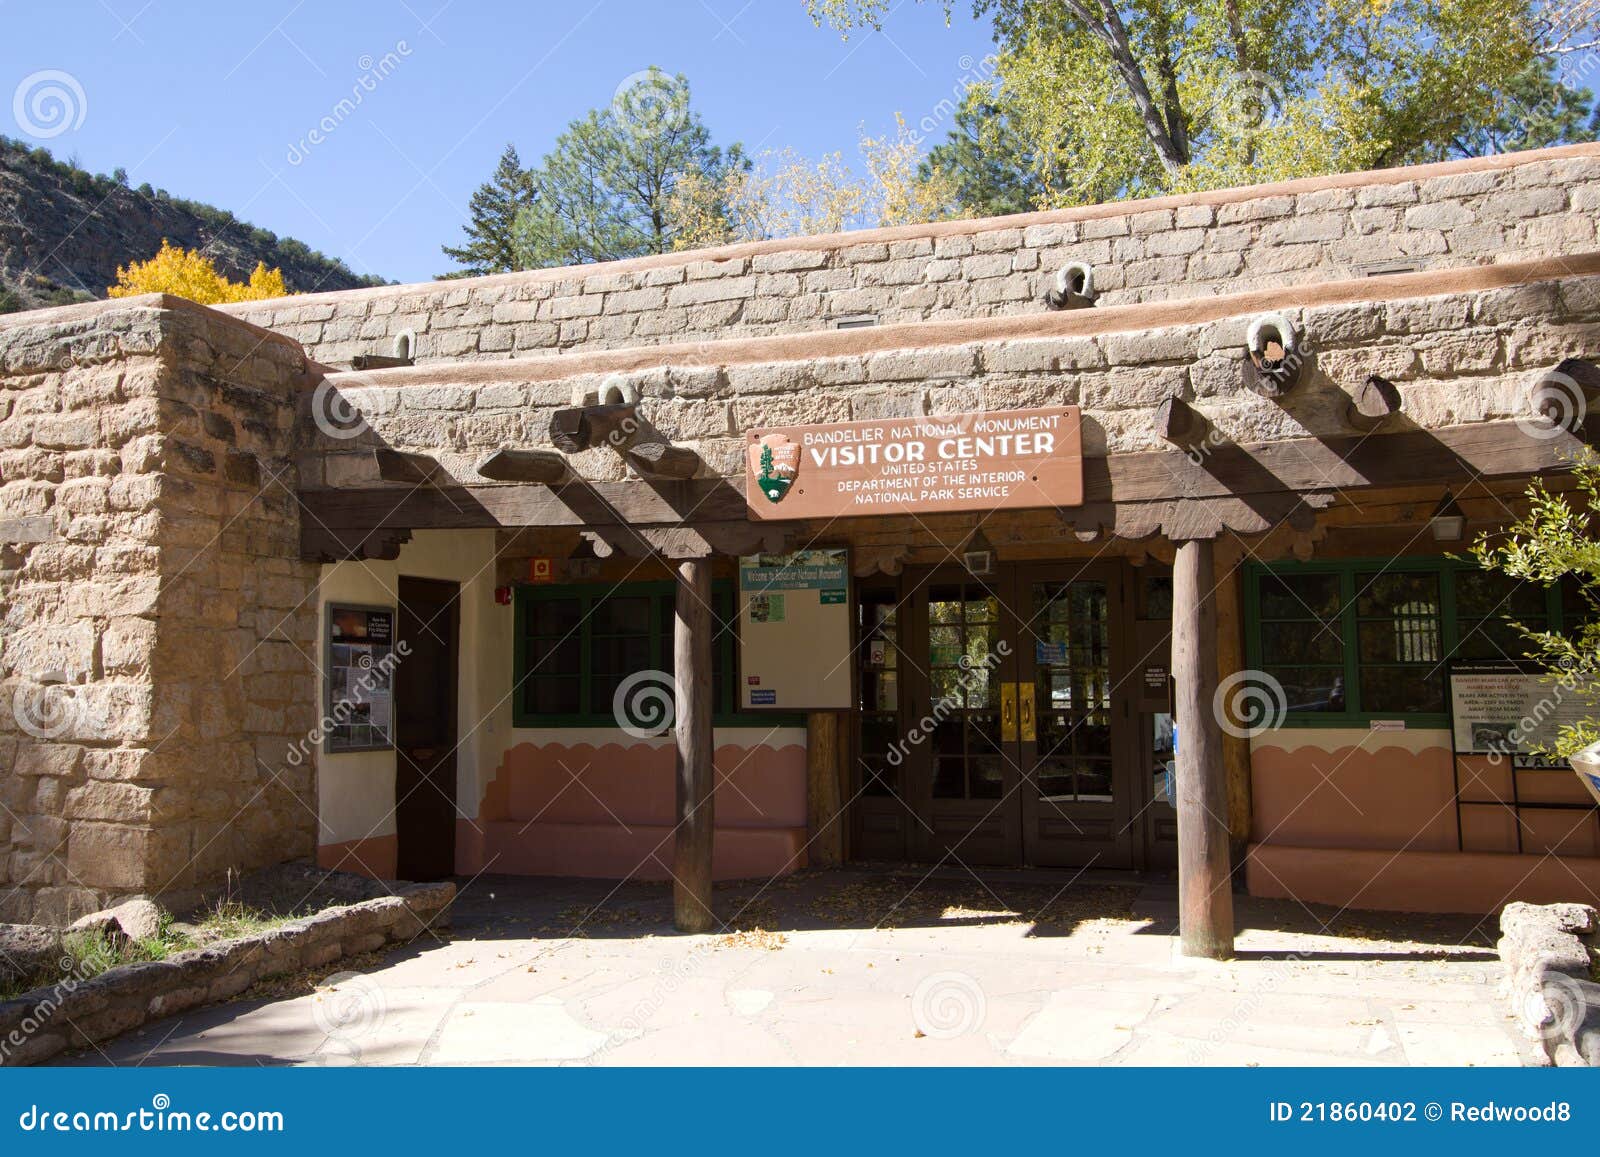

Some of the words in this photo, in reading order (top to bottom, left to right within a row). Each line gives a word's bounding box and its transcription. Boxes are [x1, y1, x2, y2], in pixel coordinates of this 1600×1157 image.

[803, 427, 884, 446] BANDELIER
[891, 422, 965, 441] NATIONAL
[975, 415, 1060, 433] MONUMENT
[810, 441, 925, 467] VISITOR
[938, 432, 1054, 460] CENTER
[881, 461, 925, 476] UNITED
[928, 459, 978, 473] STATES
[837, 476, 920, 493] DEPARTMENT
[922, 475, 939, 488] OF
[942, 474, 966, 486] THE
[969, 471, 1026, 485] INTERIOR
[855, 490, 918, 505] NATIONAL
[920, 488, 955, 501] PARK
[958, 485, 1010, 499] SERVICE
